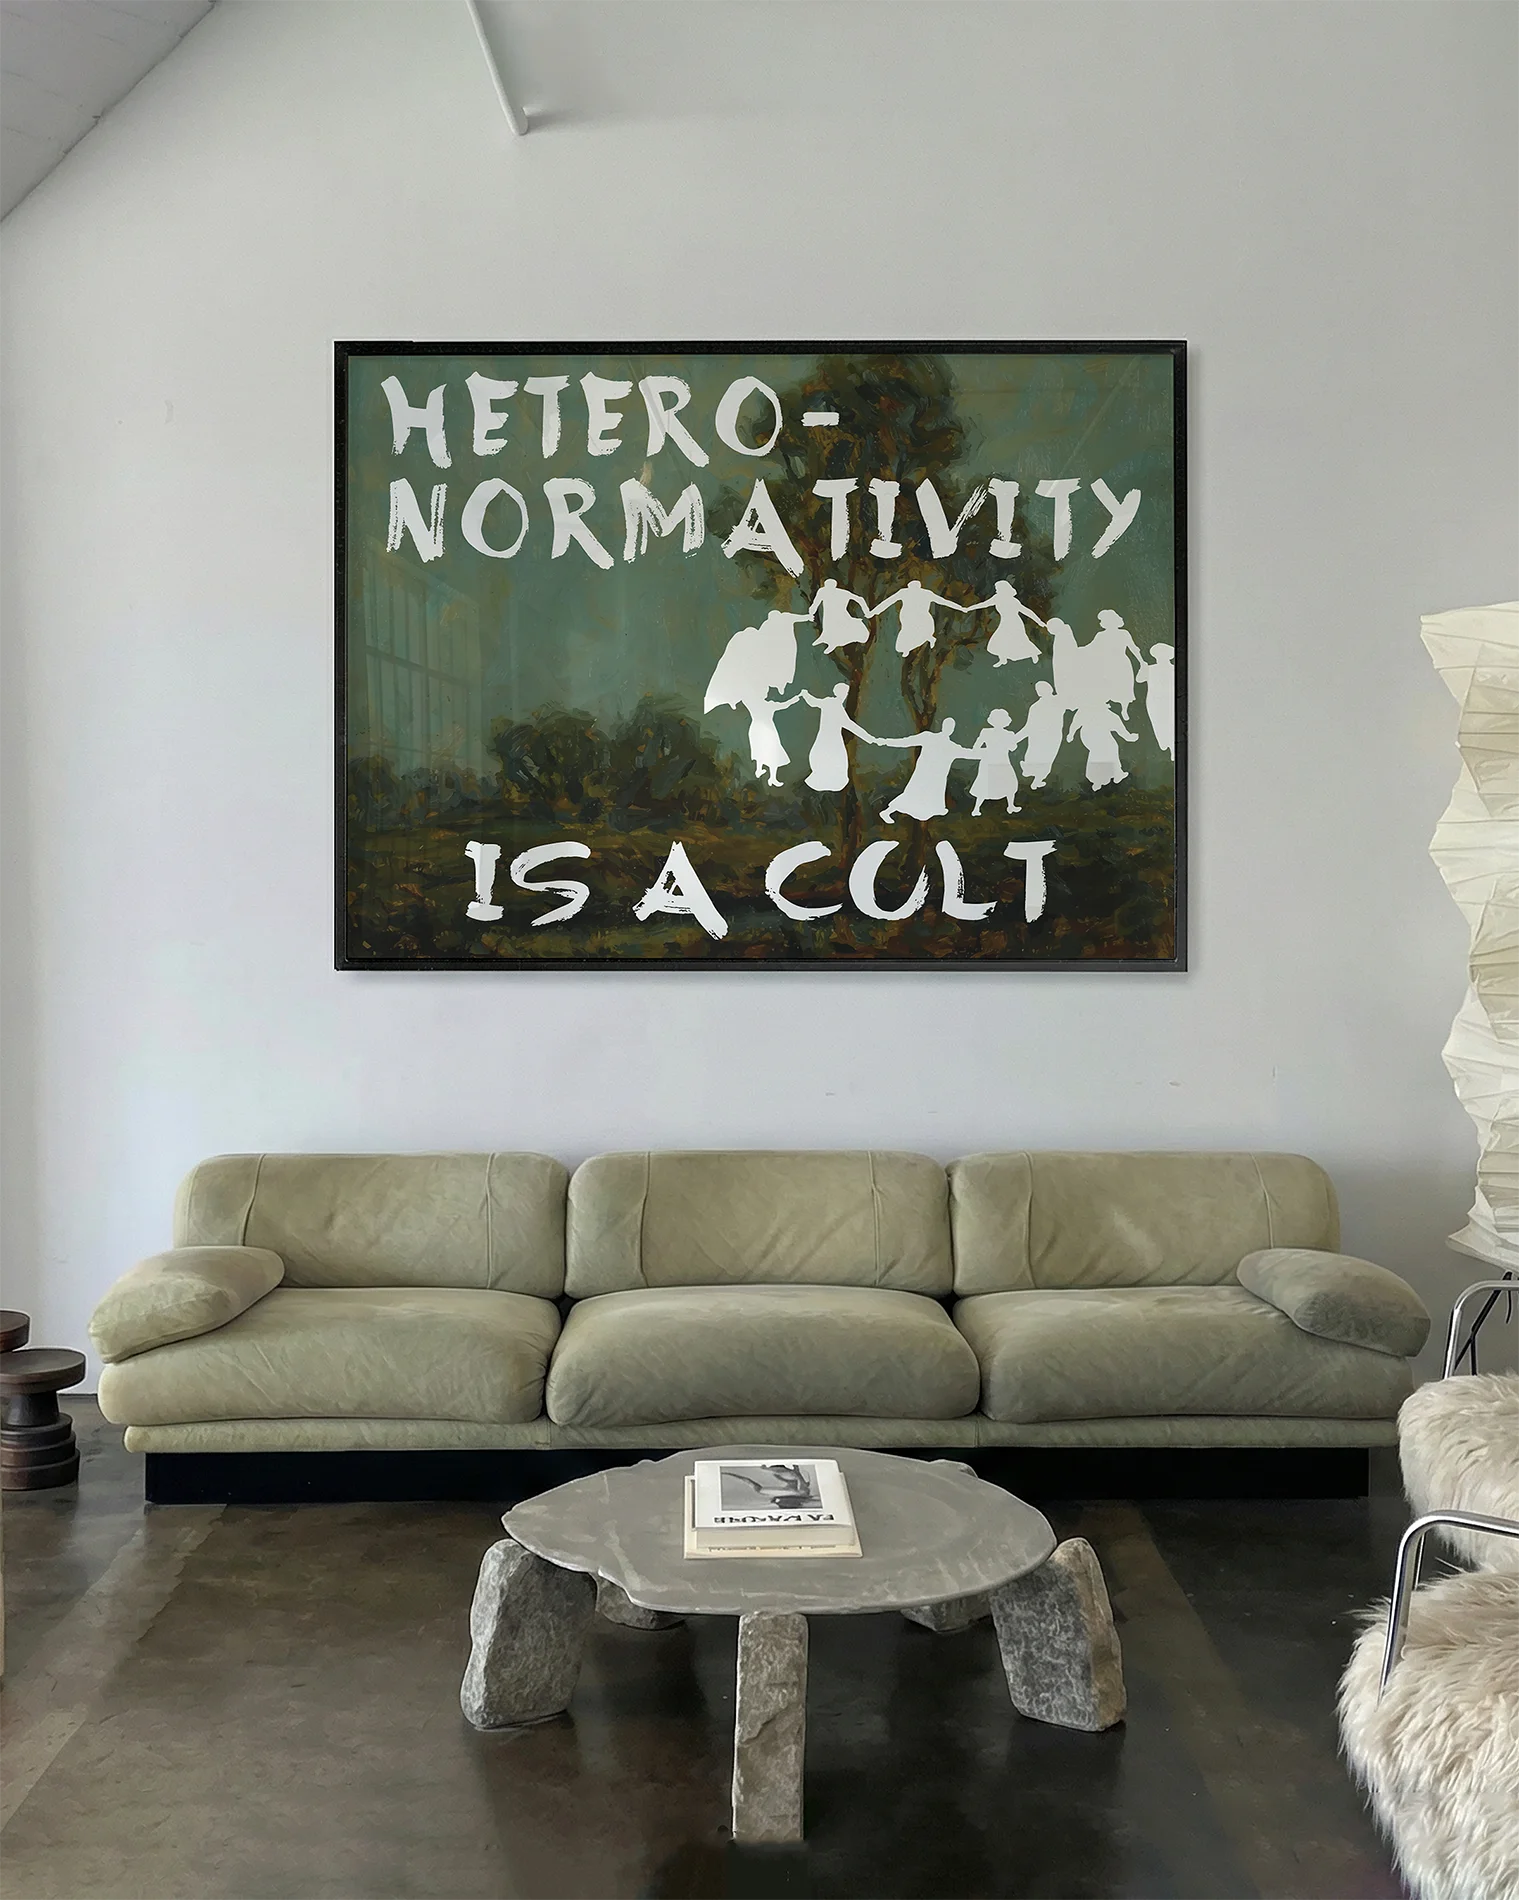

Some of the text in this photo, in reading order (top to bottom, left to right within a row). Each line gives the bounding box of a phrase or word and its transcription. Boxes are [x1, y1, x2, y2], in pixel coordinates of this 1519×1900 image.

[381, 372, 839, 469] HETERO-
[387, 477, 1141, 577] NORMATIVITY
[465, 840, 1057, 940] IS A CULT
